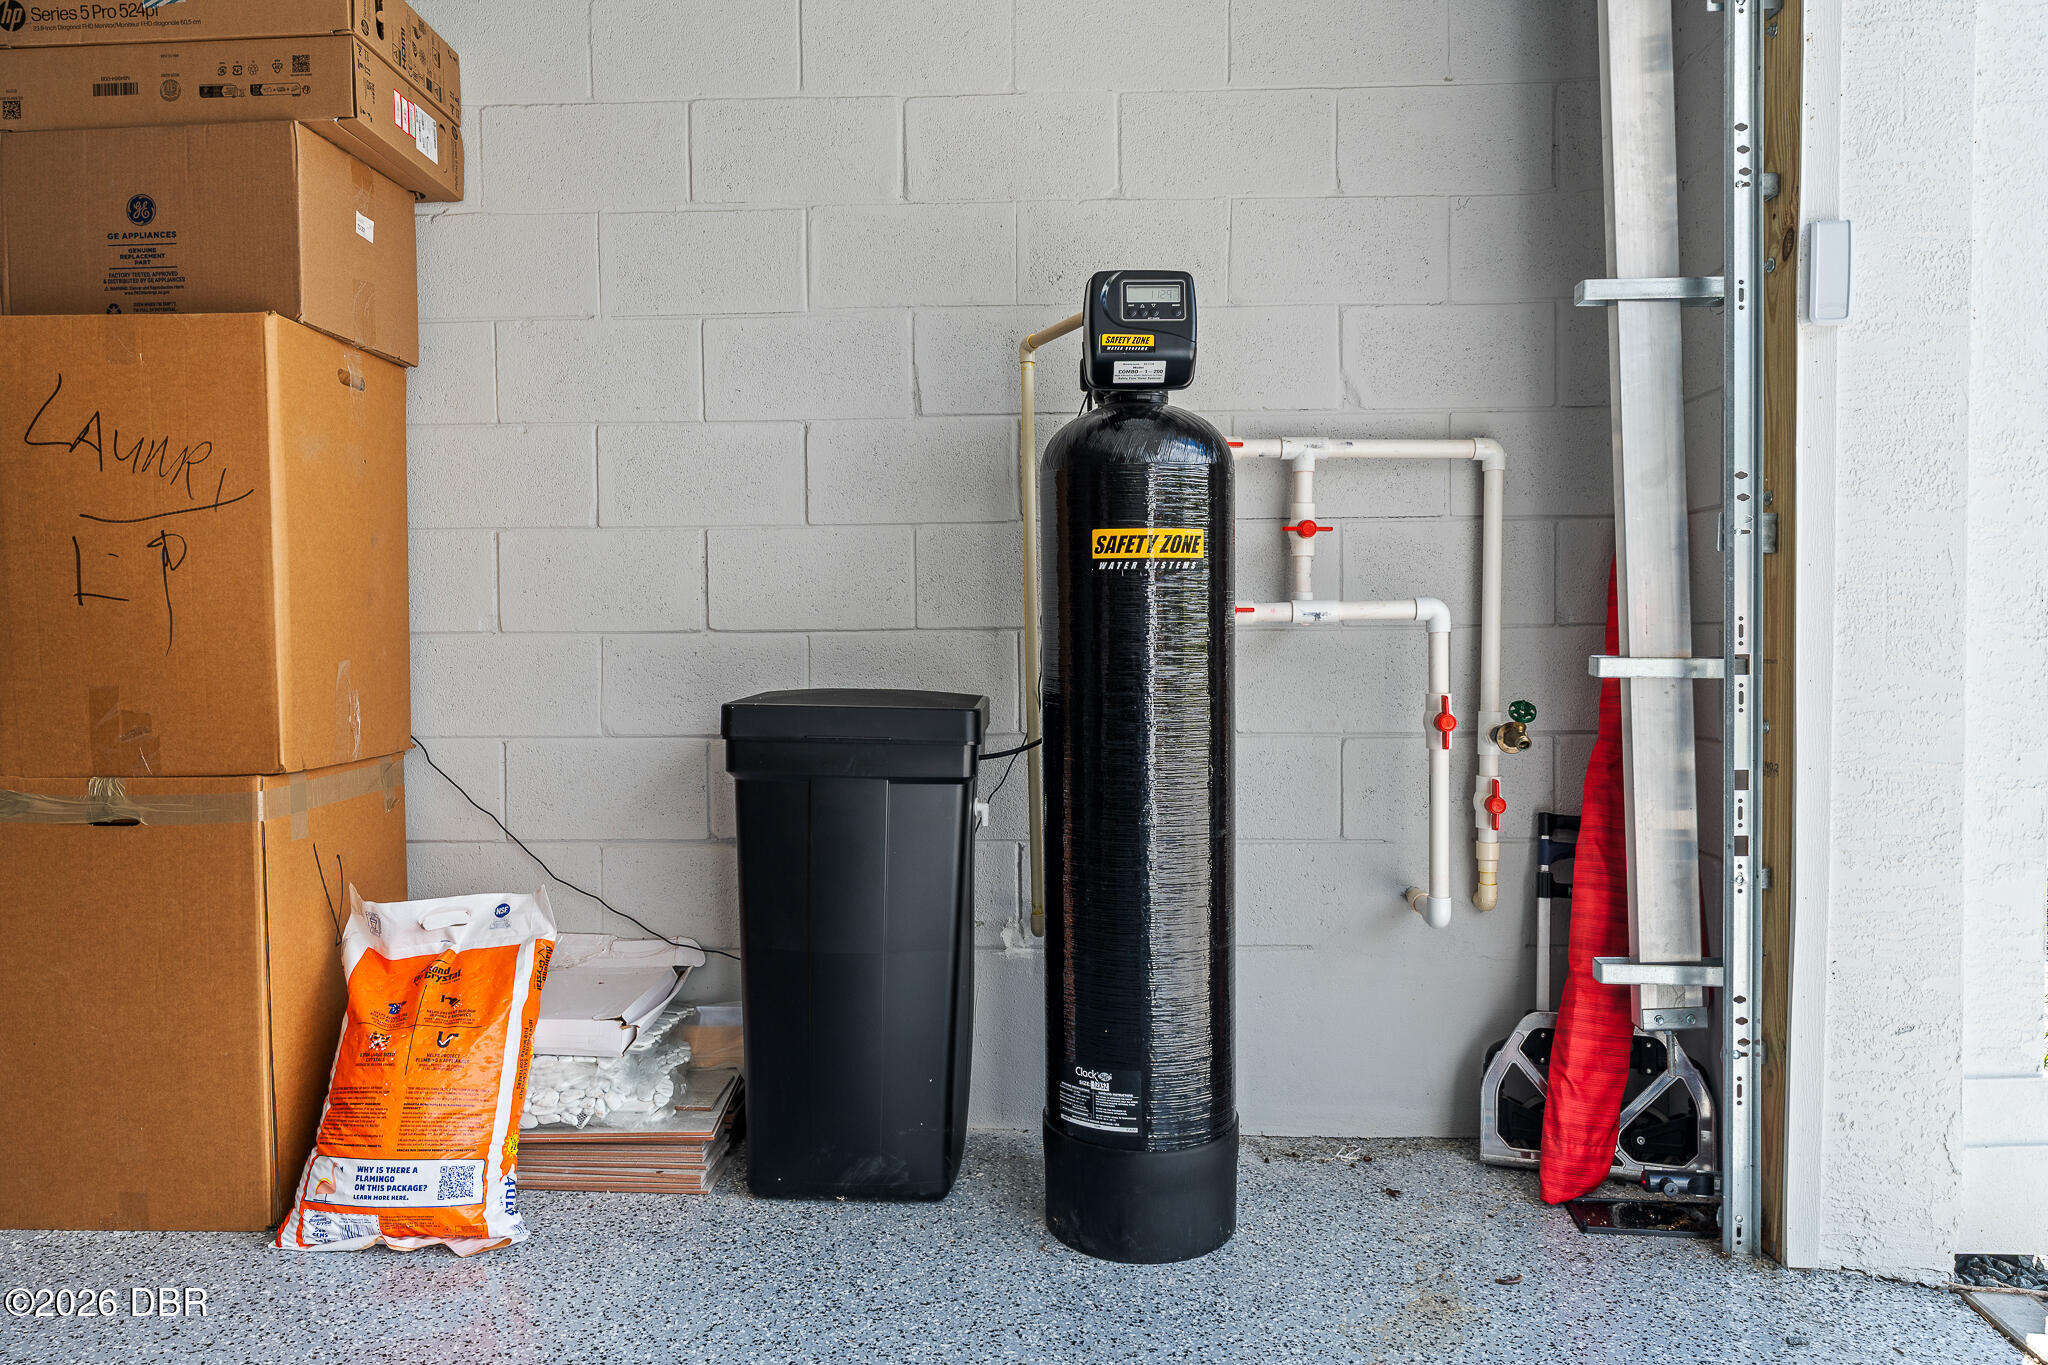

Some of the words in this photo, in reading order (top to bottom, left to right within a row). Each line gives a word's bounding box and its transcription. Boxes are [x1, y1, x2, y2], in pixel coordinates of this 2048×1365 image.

[30, 7, 77, 21] Series
[80, 5, 89, 19] 5
[92, 4, 117, 19] Pro
[122, 231, 177, 240] APPLIANCES
[1105, 336, 1131, 344] SAFETY
[1131, 336, 1150, 344] ZONE
[1094, 535, 1159, 554] SAFETY
[1159, 535, 1202, 553] ZONE
[1098, 561, 1138, 570] WATER
[1144, 561, 1197, 570] SYSTEMS
[495, 905, 509, 917] NSF
[536, 959, 546, 991] Crystal
[516, 1058, 524, 1090] SOFTENERS
[1075, 1066, 1098, 1081] Clack
[357, 1166, 374, 1174] WHY
[376, 1166, 384, 1174] IS
[386, 1166, 411, 1174] THERE
[412, 1166, 418, 1174] A
[355, 1174, 396, 1183] FLAMINGO
[386, 1184, 428, 1192] PACKAGE?
